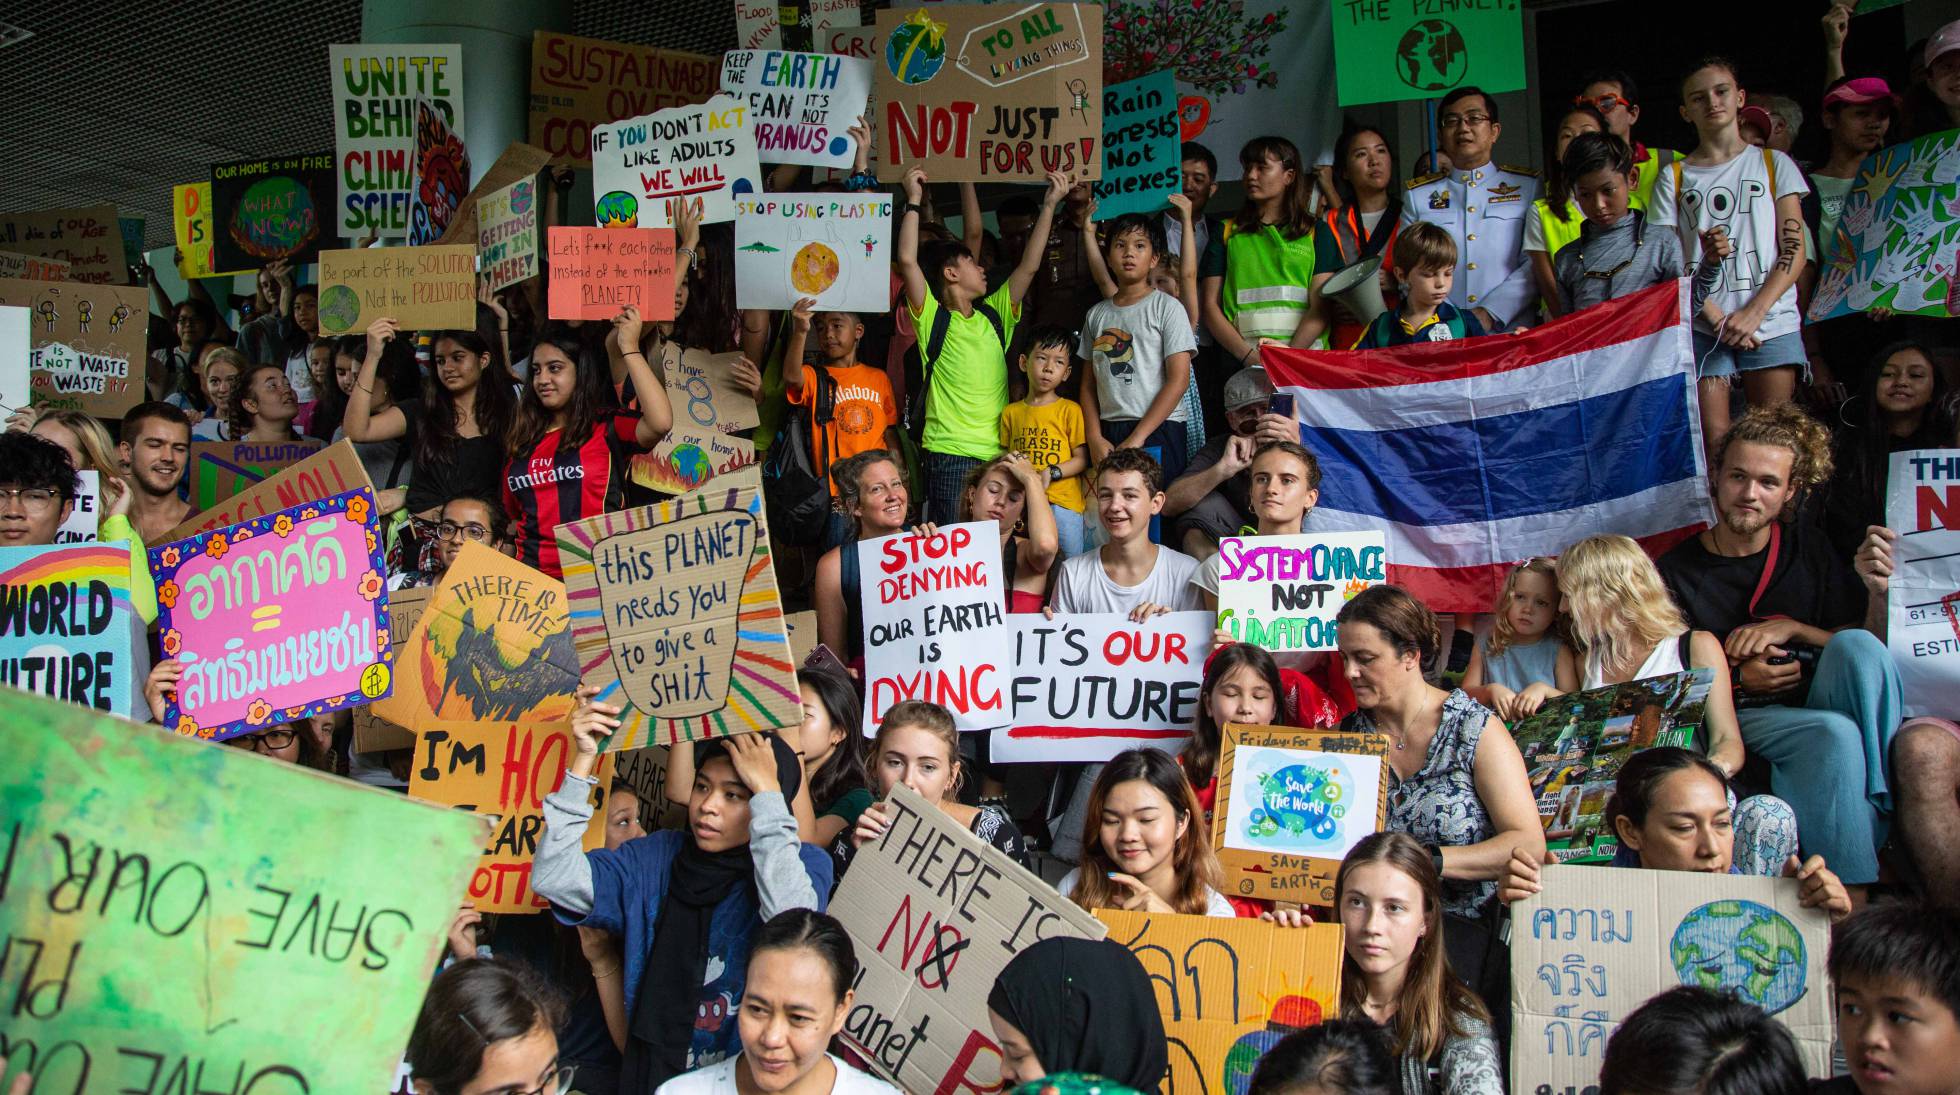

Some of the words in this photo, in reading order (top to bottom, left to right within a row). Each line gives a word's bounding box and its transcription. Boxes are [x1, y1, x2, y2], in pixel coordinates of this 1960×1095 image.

[981, 28, 1014, 57] TO
[1021, 8, 1064, 44] ALL
[343, 56, 450, 96] UNITE
[547, 38, 722, 95] SUSTAINABI
[725, 52, 753, 69] KEEP
[727, 70, 746, 84] THE
[761, 51, 841, 90] EARTH
[990, 52, 1041, 78] LIVING
[1044, 38, 1083, 59] THINGS
[724, 91, 794, 120] EAN
[805, 94, 830, 108] IT'S
[801, 110, 829, 124] NOT
[1103, 86, 1162, 116] Rain
[593, 132, 608, 151] IF
[617, 124, 647, 149] YOU
[652, 113, 703, 141] DON'T
[708, 107, 747, 132] ACT
[886, 100, 978, 166] NOT
[986, 105, 1059, 140] JUST
[1102, 110, 1179, 148] orests
[216, 166, 237, 180] OUR
[239, 161, 270, 177] HOME
[301, 155, 333, 171] FIRE
[624, 149, 660, 168] LIKE
[670, 139, 736, 164] ADULTS
[980, 140, 1034, 176] FOR
[1040, 137, 1095, 176] US!
[1107, 144, 1156, 170] Not
[640, 169, 675, 193] WE
[680, 163, 726, 186] WILL
[244, 191, 297, 214] WHAT
[738, 202, 777, 215] STOP
[783, 202, 825, 219] USING
[830, 202, 891, 218] PLASTIC
[1679, 180, 1765, 230] POP
[50, 218, 64, 239] of
[67, 218, 97, 230] OLD
[82, 226, 109, 239] AGE
[481, 209, 535, 248] GETTING
[553, 234, 580, 256] Let's
[620, 240, 647, 257] each
[649, 241, 673, 256] other
[483, 242, 507, 268] HOT
[512, 229, 533, 254] IN
[323, 263, 337, 281] Be
[343, 256, 369, 284] part
[373, 256, 392, 279] of
[395, 259, 415, 278] the
[417, 254, 476, 275] SOLUTION
[596, 263, 608, 279] of
[612, 263, 628, 278] the
[365, 288, 387, 309] Not
[391, 287, 407, 306] the
[412, 281, 477, 305] POLLUTION
[46, 359, 72, 369] NOT
[80, 355, 127, 376] WASTE
[55, 374, 104, 392] WASTE
[683, 435, 702, 445] our
[711, 436, 735, 455] home
[716, 422, 740, 433] YEARS
[1014, 437, 1062, 451] TRASH
[1022, 427, 1038, 437] I'M
[1041, 428, 1049, 437] A
[507, 465, 585, 493] Emirates
[184, 517, 347, 620] อากาศดี
[601, 543, 653, 584] this
[665, 519, 750, 573] PLANET
[880, 527, 971, 574] STOP
[450, 575, 533, 606] THERE
[535, 589, 557, 611] IS
[877, 561, 987, 604] DENYING
[1271, 583, 1335, 612] NOT
[0, 579, 113, 637] WORLD
[498, 596, 556, 639] TIME
[616, 586, 680, 627] needs
[869, 618, 914, 647] OUR
[924, 601, 1003, 637] EARTH
[621, 642, 645, 674] to
[655, 628, 695, 667] give
[704, 627, 717, 645] a
[919, 642, 942, 664] IS
[1015, 622, 1090, 667] IT'S
[1103, 629, 1188, 666] OUR
[0, 651, 114, 713] UTURE
[872, 663, 1003, 725] DYING
[1012, 675, 1201, 724] FUTURE
[420, 730, 486, 781] I'M
[1285, 776, 1314, 794] Save
[1293, 796, 1325, 816] World
[879, 797, 1002, 924] THERE
[1270, 855, 1311, 871] SAVE
[1599, 845, 1617, 856] NOW
[1270, 873, 1321, 889] EARTH
[49, 833, 210, 938] OUR
[236, 883, 414, 971] SAVE
[1533, 907, 1633, 943] ความ
[1537, 953, 1607, 998] จริง
